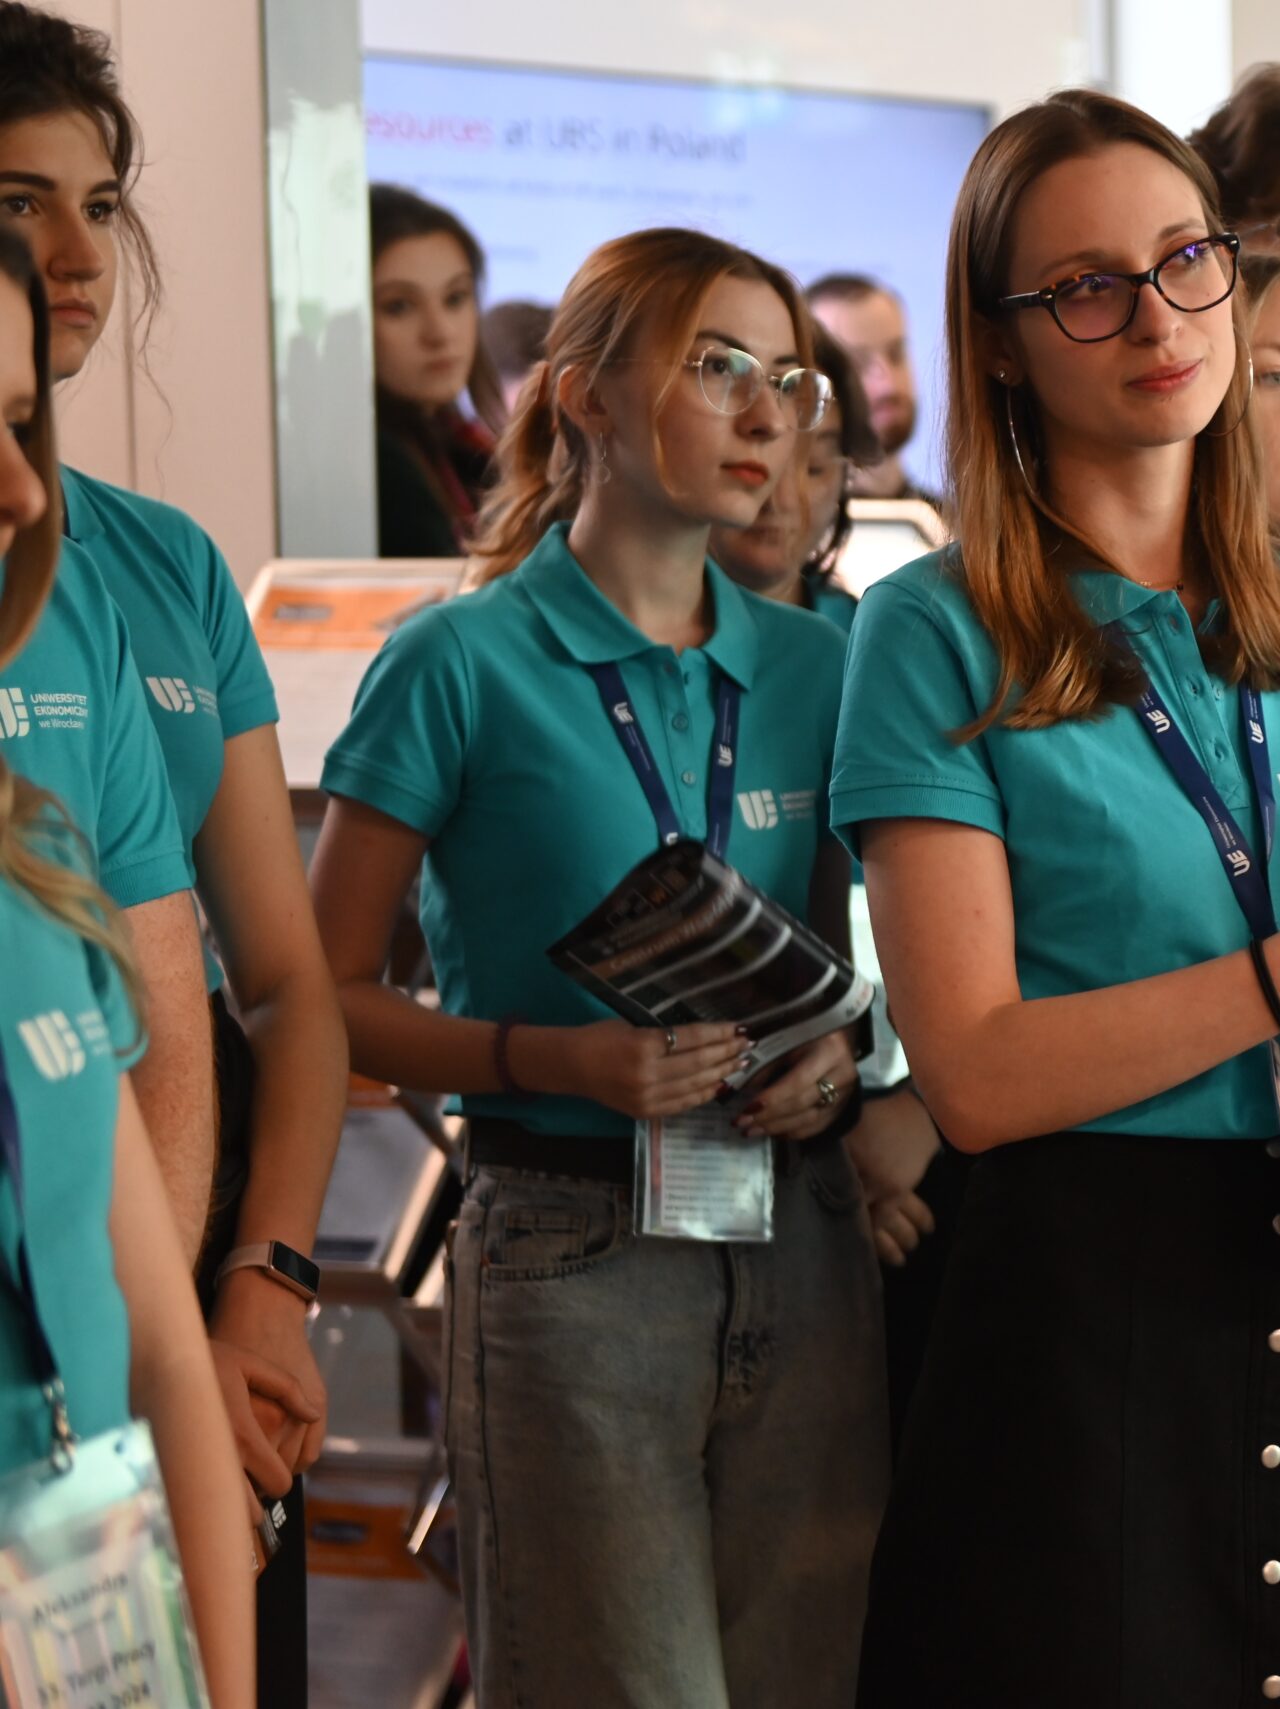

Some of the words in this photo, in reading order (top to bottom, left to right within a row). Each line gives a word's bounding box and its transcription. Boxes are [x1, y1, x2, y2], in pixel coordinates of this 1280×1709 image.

[364, 110, 495, 146] esources
[504, 115, 539, 146] at
[545, 117, 599, 152] UBS
[1227, 849, 1250, 877] UE
